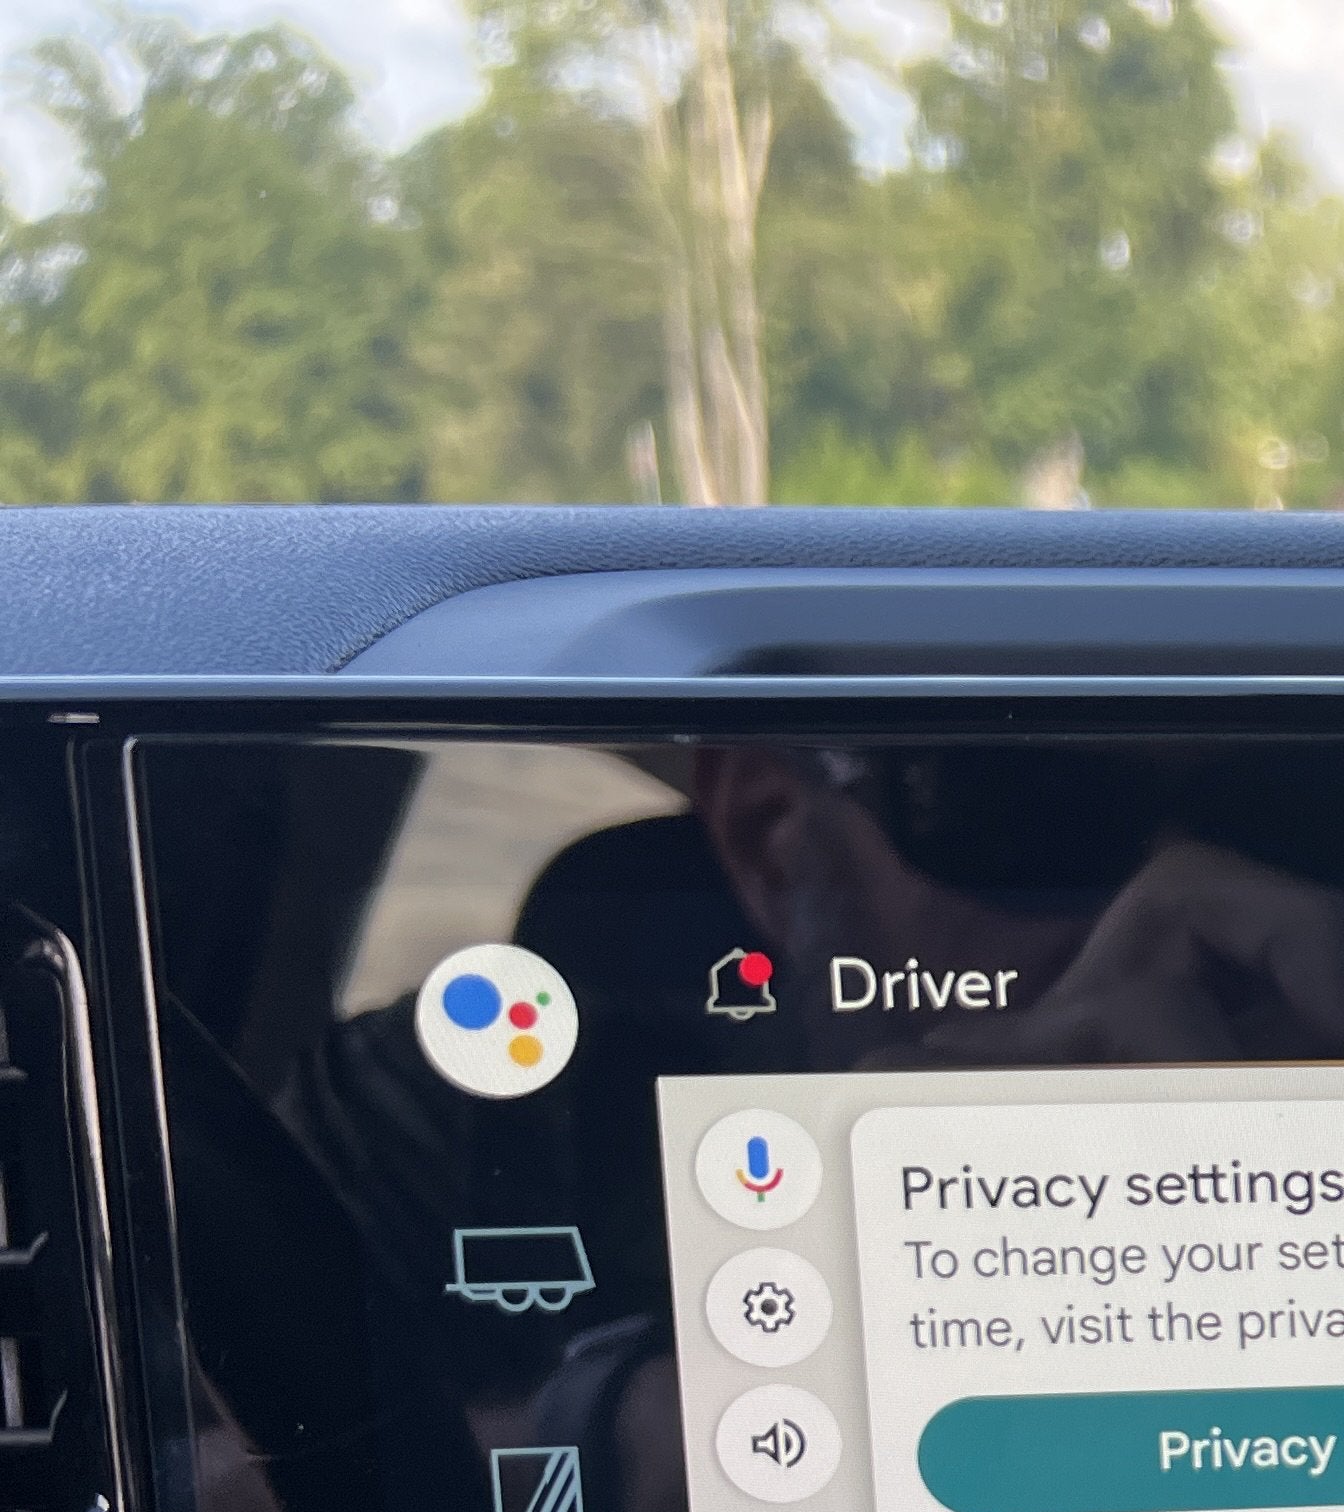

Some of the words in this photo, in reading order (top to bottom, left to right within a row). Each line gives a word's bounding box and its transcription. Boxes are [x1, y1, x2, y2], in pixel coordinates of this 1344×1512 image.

[831, 956, 1018, 1012] Driver
[902, 1164, 1109, 1222] Privacy
[903, 1240, 959, 1280] To
[973, 1235, 1148, 1287] change
[1161, 1242, 1263, 1285] your
[909, 1307, 1026, 1353] time,
[1039, 1302, 1134, 1346] visit
[1147, 1301, 1222, 1343] the
[1159, 1426, 1337, 1476] Privacy
